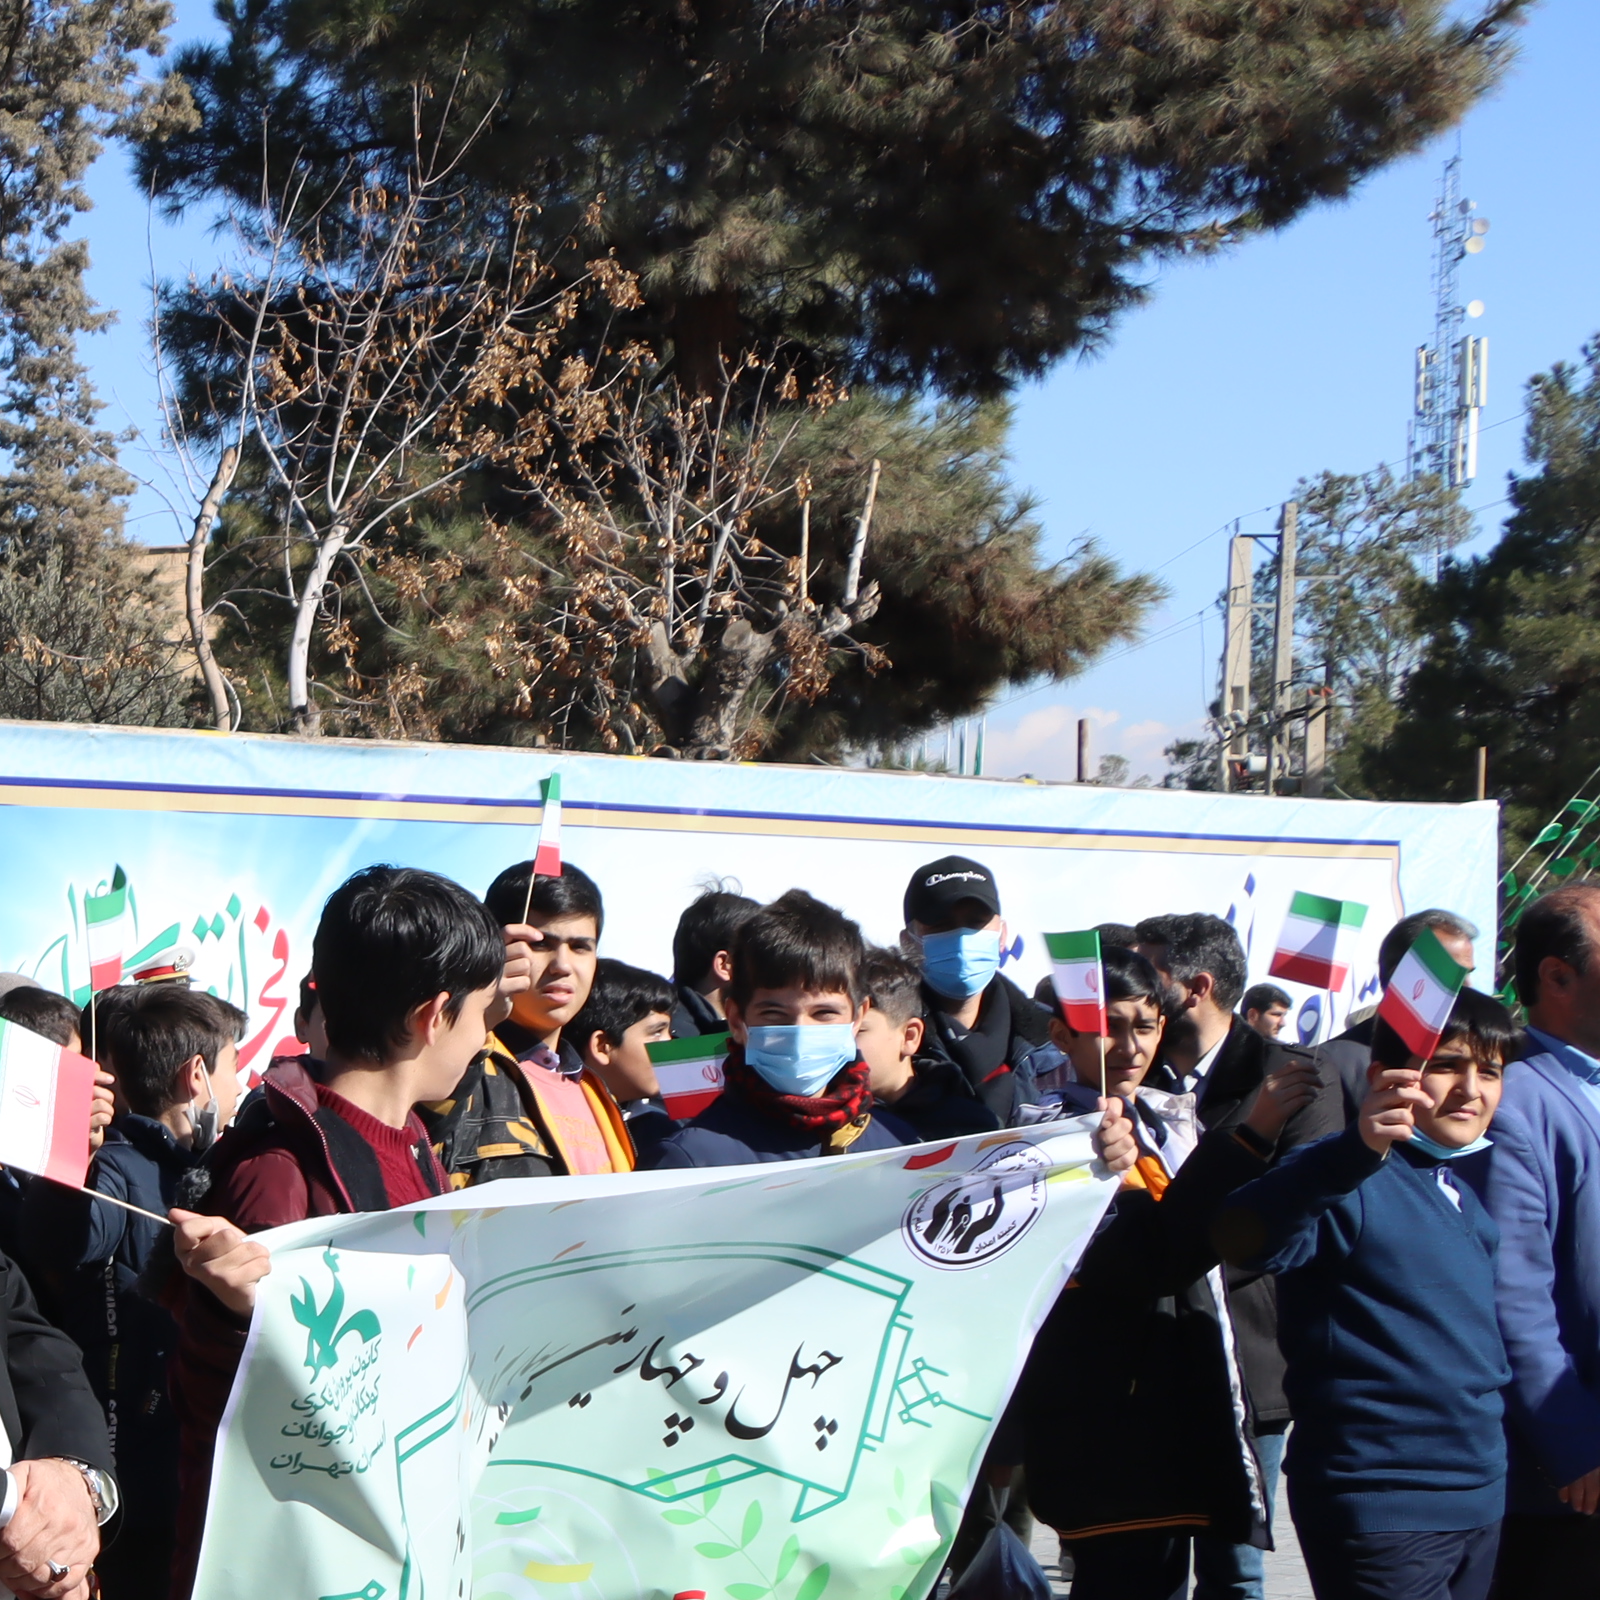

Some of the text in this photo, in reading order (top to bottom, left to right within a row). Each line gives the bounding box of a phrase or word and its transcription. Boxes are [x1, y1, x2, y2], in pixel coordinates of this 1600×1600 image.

[925, 871, 987, 887] Champion
[351, 1337, 382, 1382] کانون
[697, 1370, 730, 1405] و
[724, 1340, 844, 1452] چهل
[269, 1451, 354, 1480] تهران
